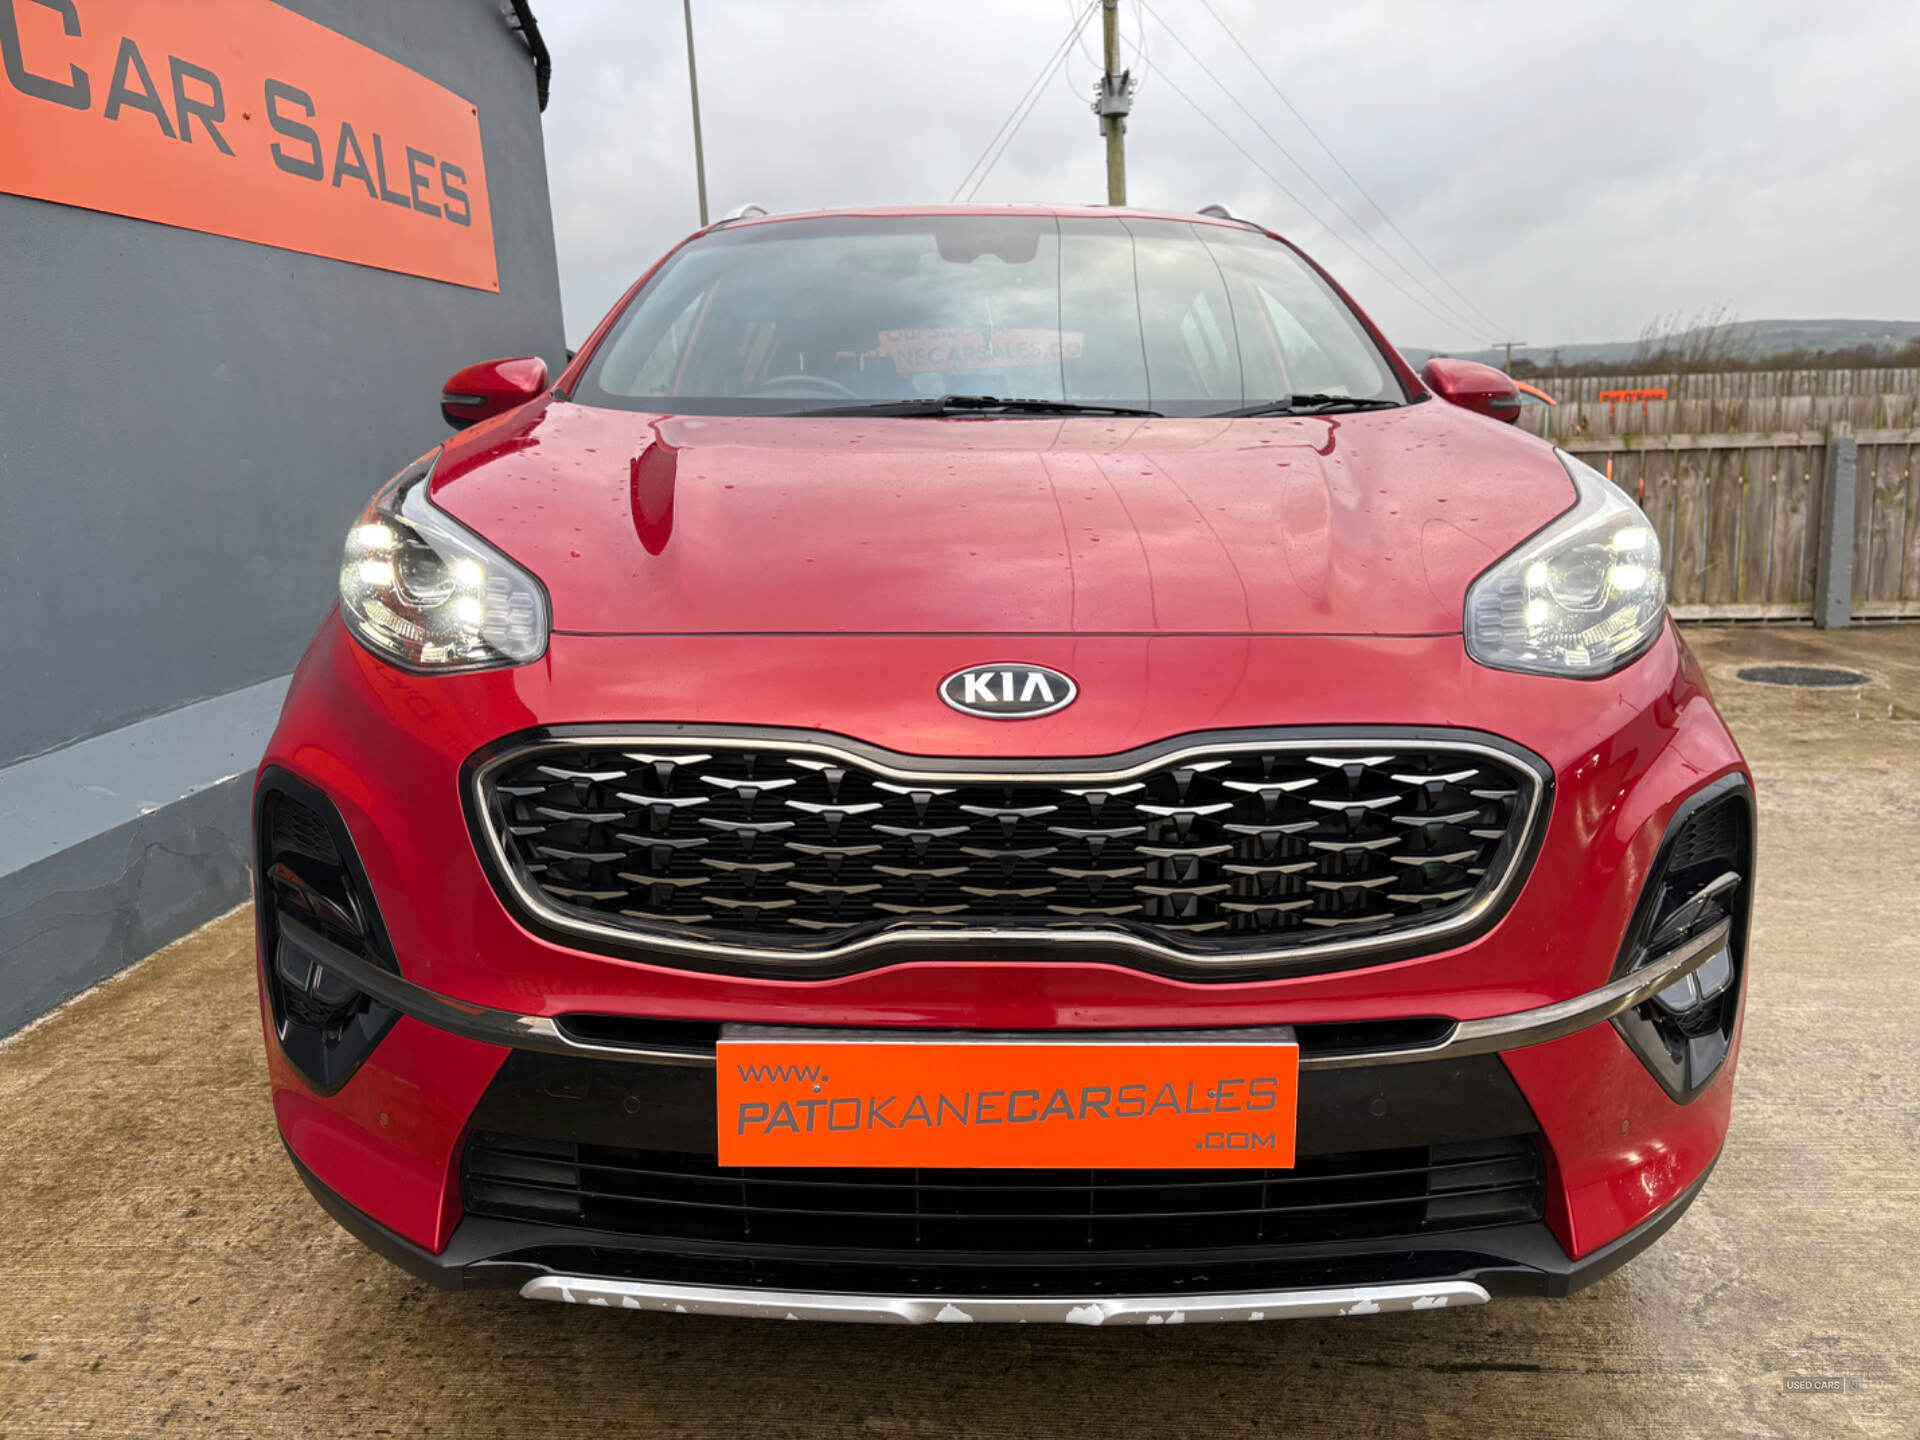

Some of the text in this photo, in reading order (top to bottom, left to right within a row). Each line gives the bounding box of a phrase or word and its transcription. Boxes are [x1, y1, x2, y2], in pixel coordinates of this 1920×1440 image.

[0, 0, 472, 228] CAR SALES
[963, 671, 1055, 704] KIA
[737, 1077, 1279, 1136] PATOKANECARSALES
[1195, 1132, 1277, 1150] .COM
